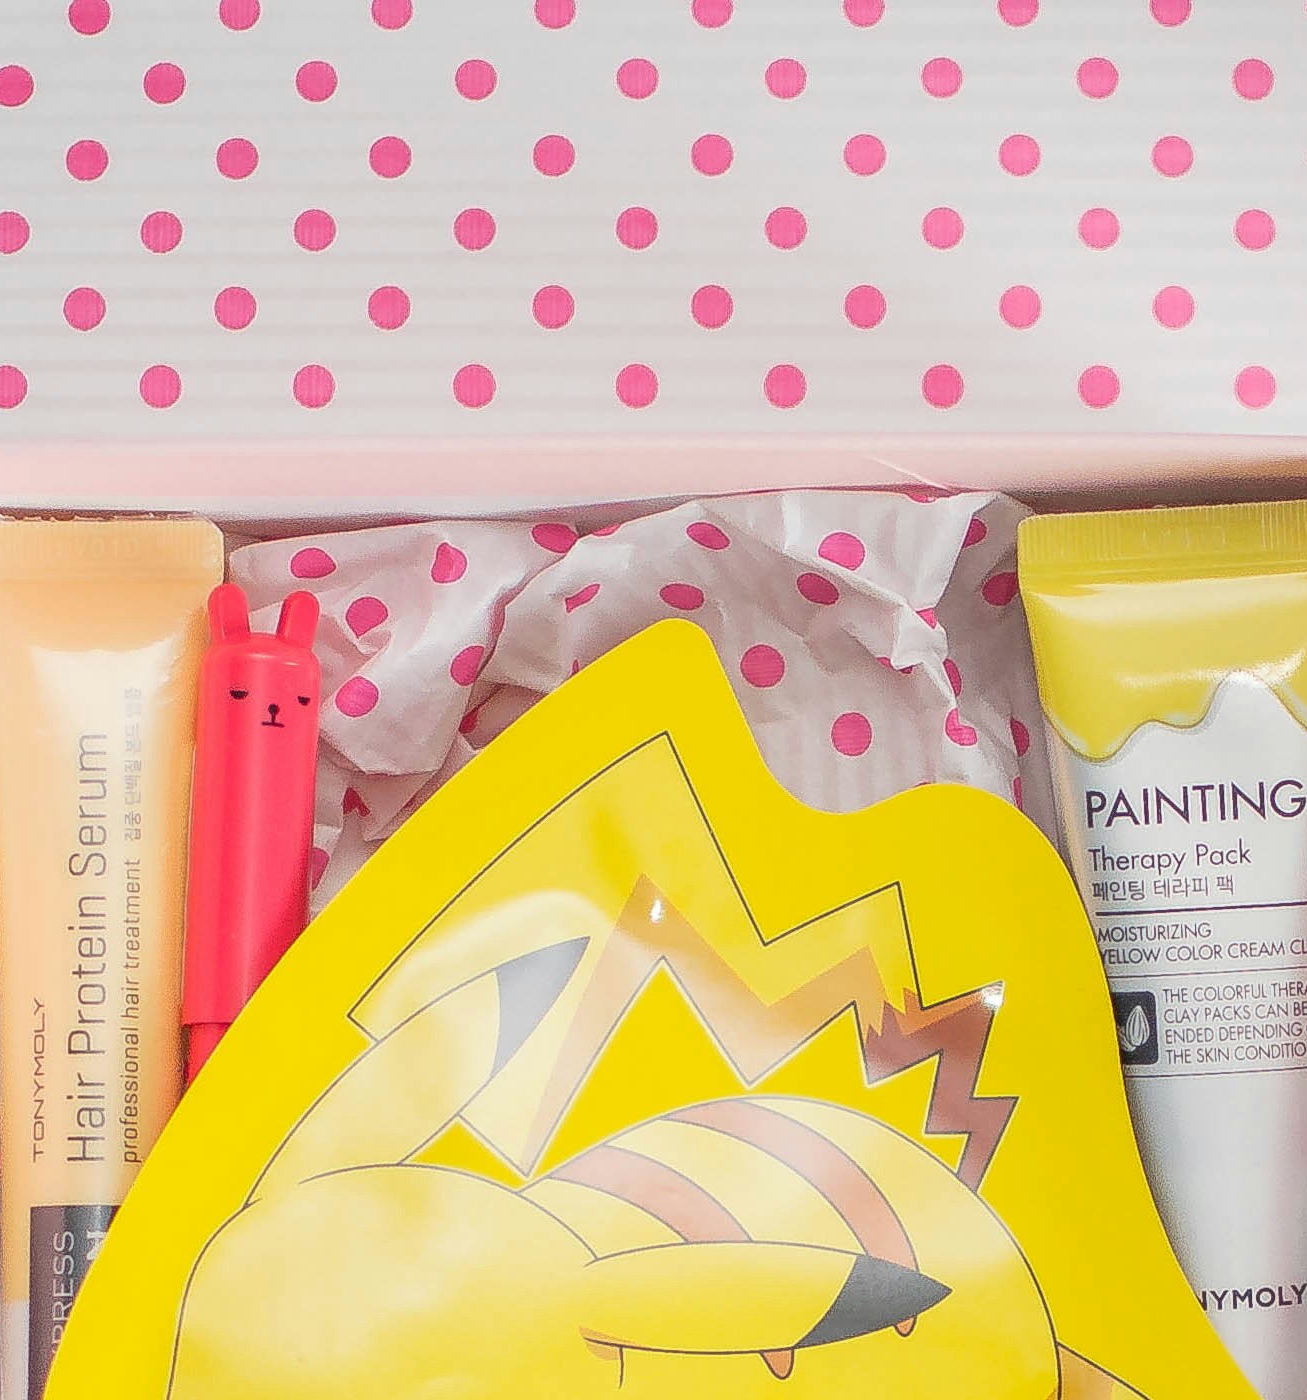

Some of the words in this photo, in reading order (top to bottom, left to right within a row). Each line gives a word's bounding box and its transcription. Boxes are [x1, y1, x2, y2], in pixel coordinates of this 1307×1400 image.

[67, 732, 108, 877] Serum
[1085, 779, 1307, 829] PAINTING
[1088, 845, 1186, 875] Therapy
[1195, 838, 1252, 867] Pack
[1092, 879, 1145, 901] 페인팅
[1153, 877, 1210, 898] 테라피
[1216, 874, 1234, 895] 팩
[123, 858, 141, 969] treatment
[1097, 922, 1212, 943] MOISTURIZING
[1100, 947, 1161, 966] YELLOW
[1165, 942, 1223, 963] COLOR
[1228, 939, 1286, 960] CREAM
[67, 895, 107, 1056] Protein
[1162, 987, 1189, 1003] THE
[1193, 983, 1268, 1002] COLORFUL
[121, 980, 141, 1018] hair
[1164, 1008, 1201, 1025] CLAY
[1204, 1005, 1252, 1023] PACKS
[1254, 1003, 1289, 1021] CAN
[1165, 1025, 1214, 1045] ENDED
[1218, 1022, 1303, 1043] DEPENDING
[1165, 1049, 1193, 1065] THE
[1196, 1046, 1230, 1064] SKIN
[30, 997, 46, 1163] TONYMOLY
[120, 1027, 142, 1164] professional
[67, 1070, 106, 1163] Hair
[51, 1230, 75, 1353] PRESS
[1198, 1283, 1307, 1312] NYMOLY
